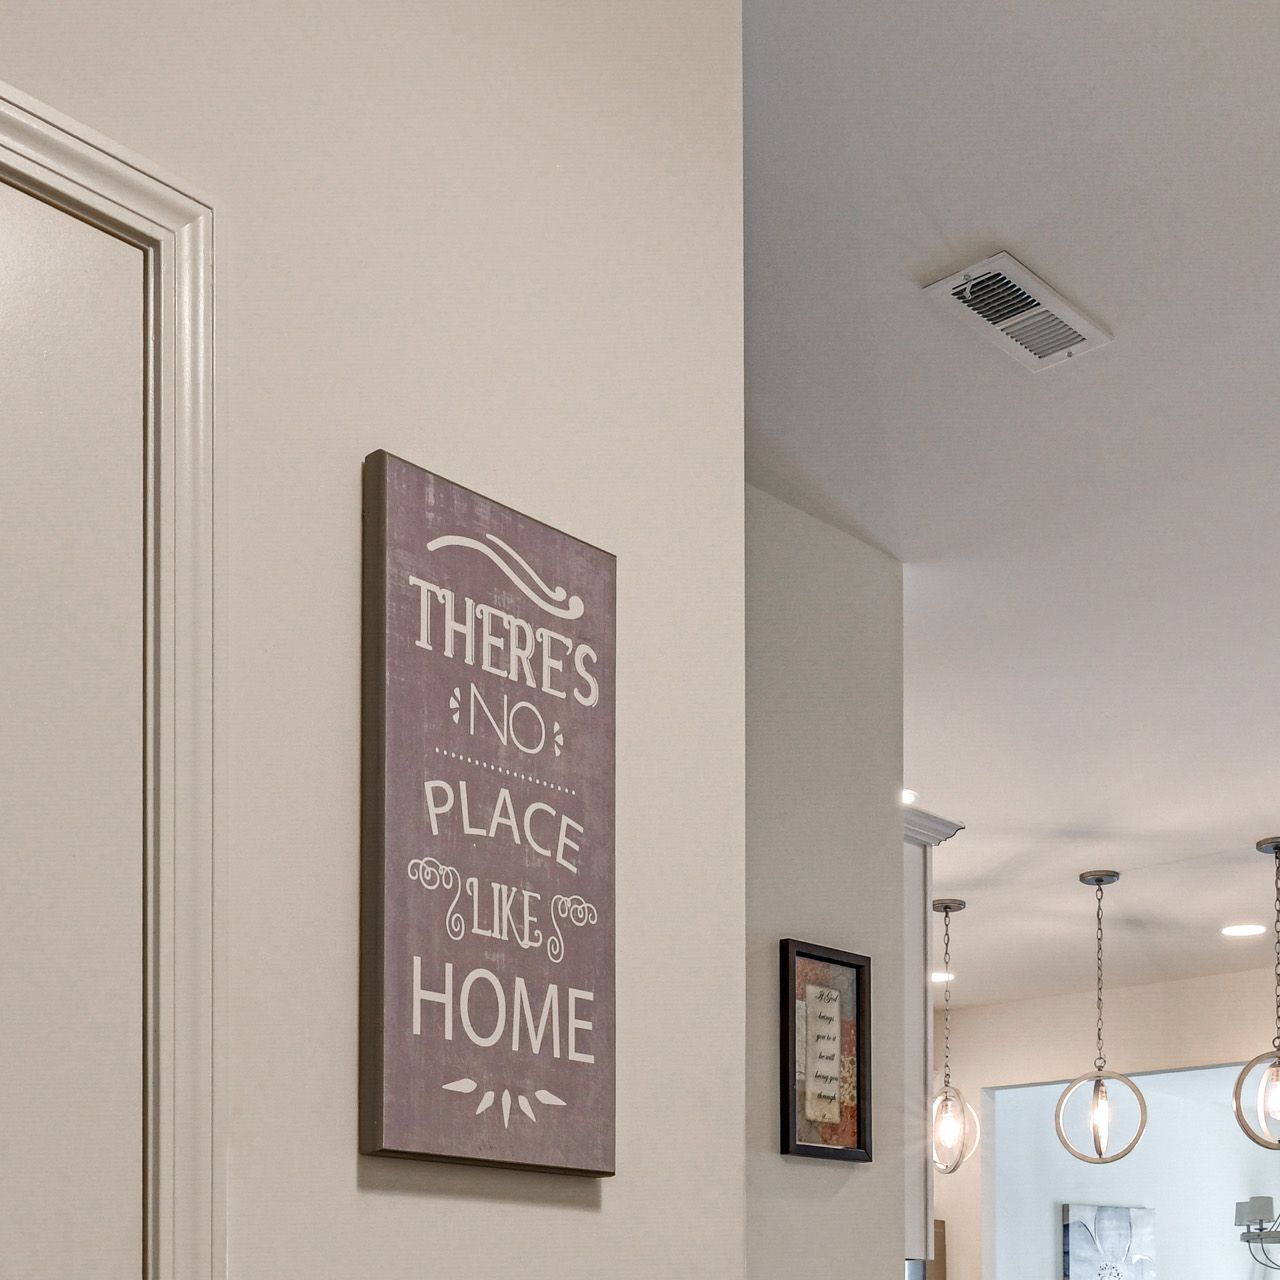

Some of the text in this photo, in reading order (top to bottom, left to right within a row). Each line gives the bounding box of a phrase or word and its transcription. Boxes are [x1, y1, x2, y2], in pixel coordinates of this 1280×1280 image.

[408, 575, 600, 709] THERE'S
[468, 682, 548, 756] NO
[423, 779, 585, 875] PLACE
[465, 876, 544, 950] LIKE
[411, 955, 596, 1065] HOME
